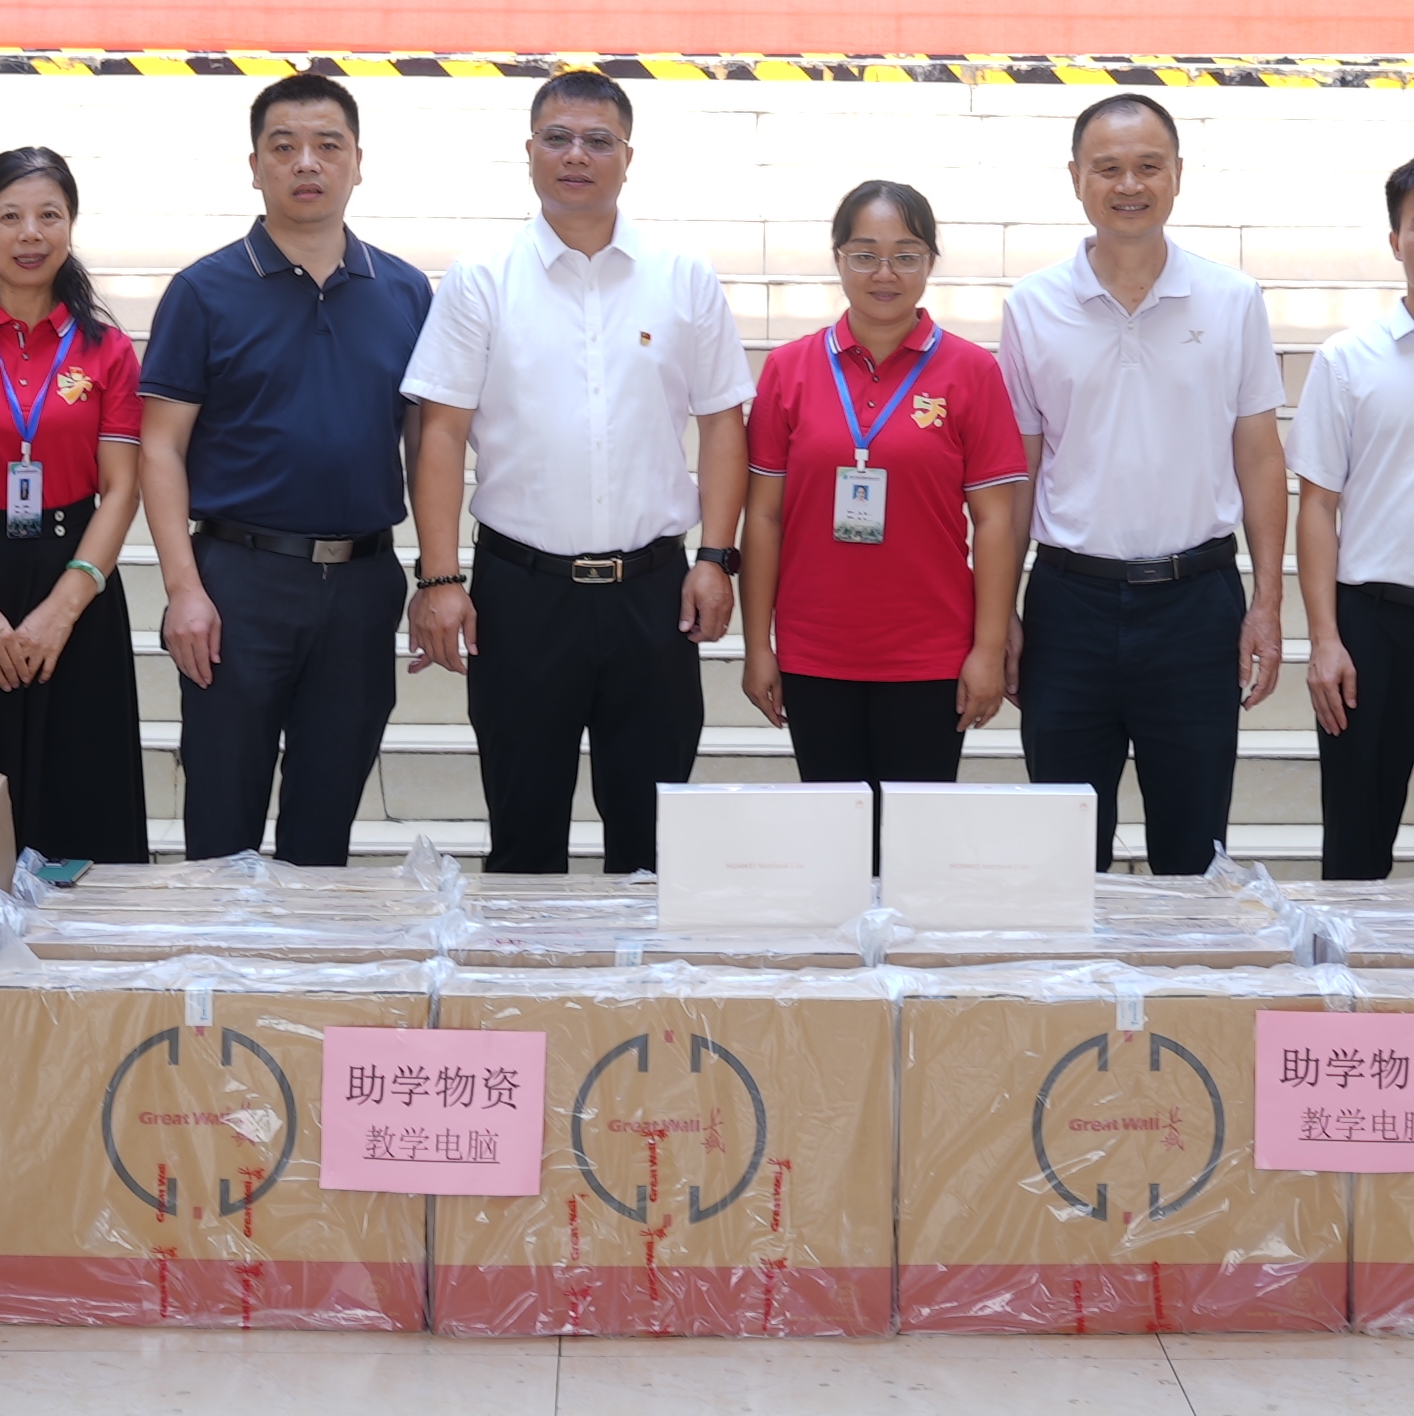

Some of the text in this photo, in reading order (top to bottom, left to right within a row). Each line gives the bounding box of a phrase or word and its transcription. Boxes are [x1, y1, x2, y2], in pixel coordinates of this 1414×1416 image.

[345, 1063, 521, 1110] 助学物资
[139, 1111, 190, 1126] Great
[607, 1118, 700, 1133] Great Wall
[1069, 1117, 1160, 1132] Great Wall
[363, 1124, 501, 1165] 教学电脑
